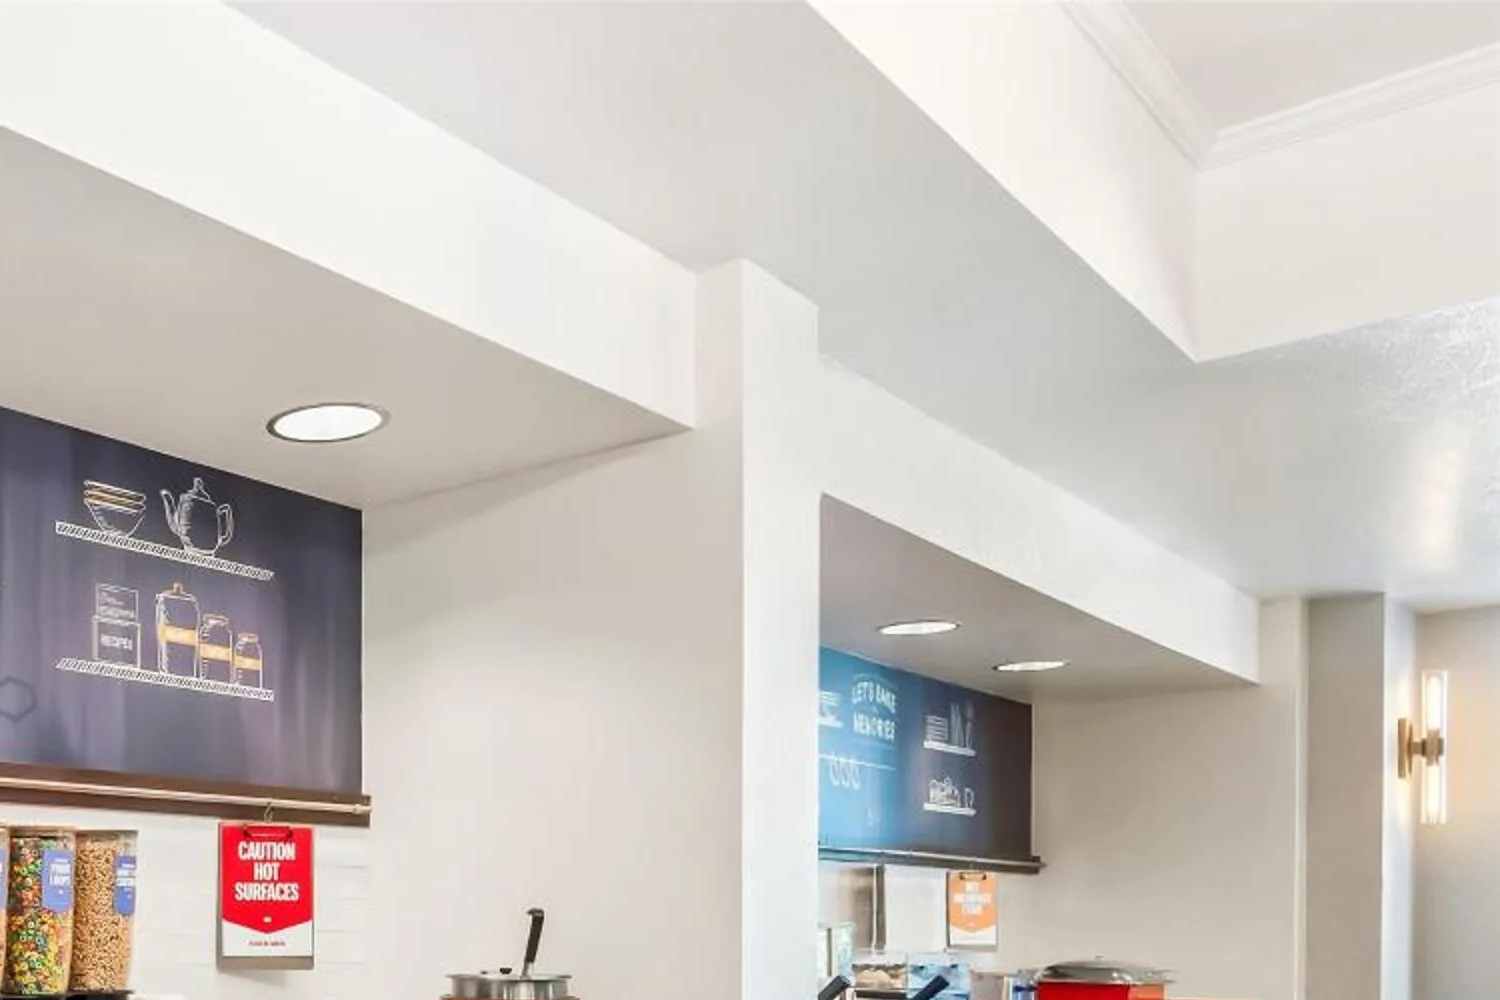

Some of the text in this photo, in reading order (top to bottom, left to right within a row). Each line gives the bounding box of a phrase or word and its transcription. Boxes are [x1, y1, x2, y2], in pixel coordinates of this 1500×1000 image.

[237, 841, 297, 861] CAUTION
[253, 862, 281, 881] HOT
[235, 881, 300, 901] SURFACES
